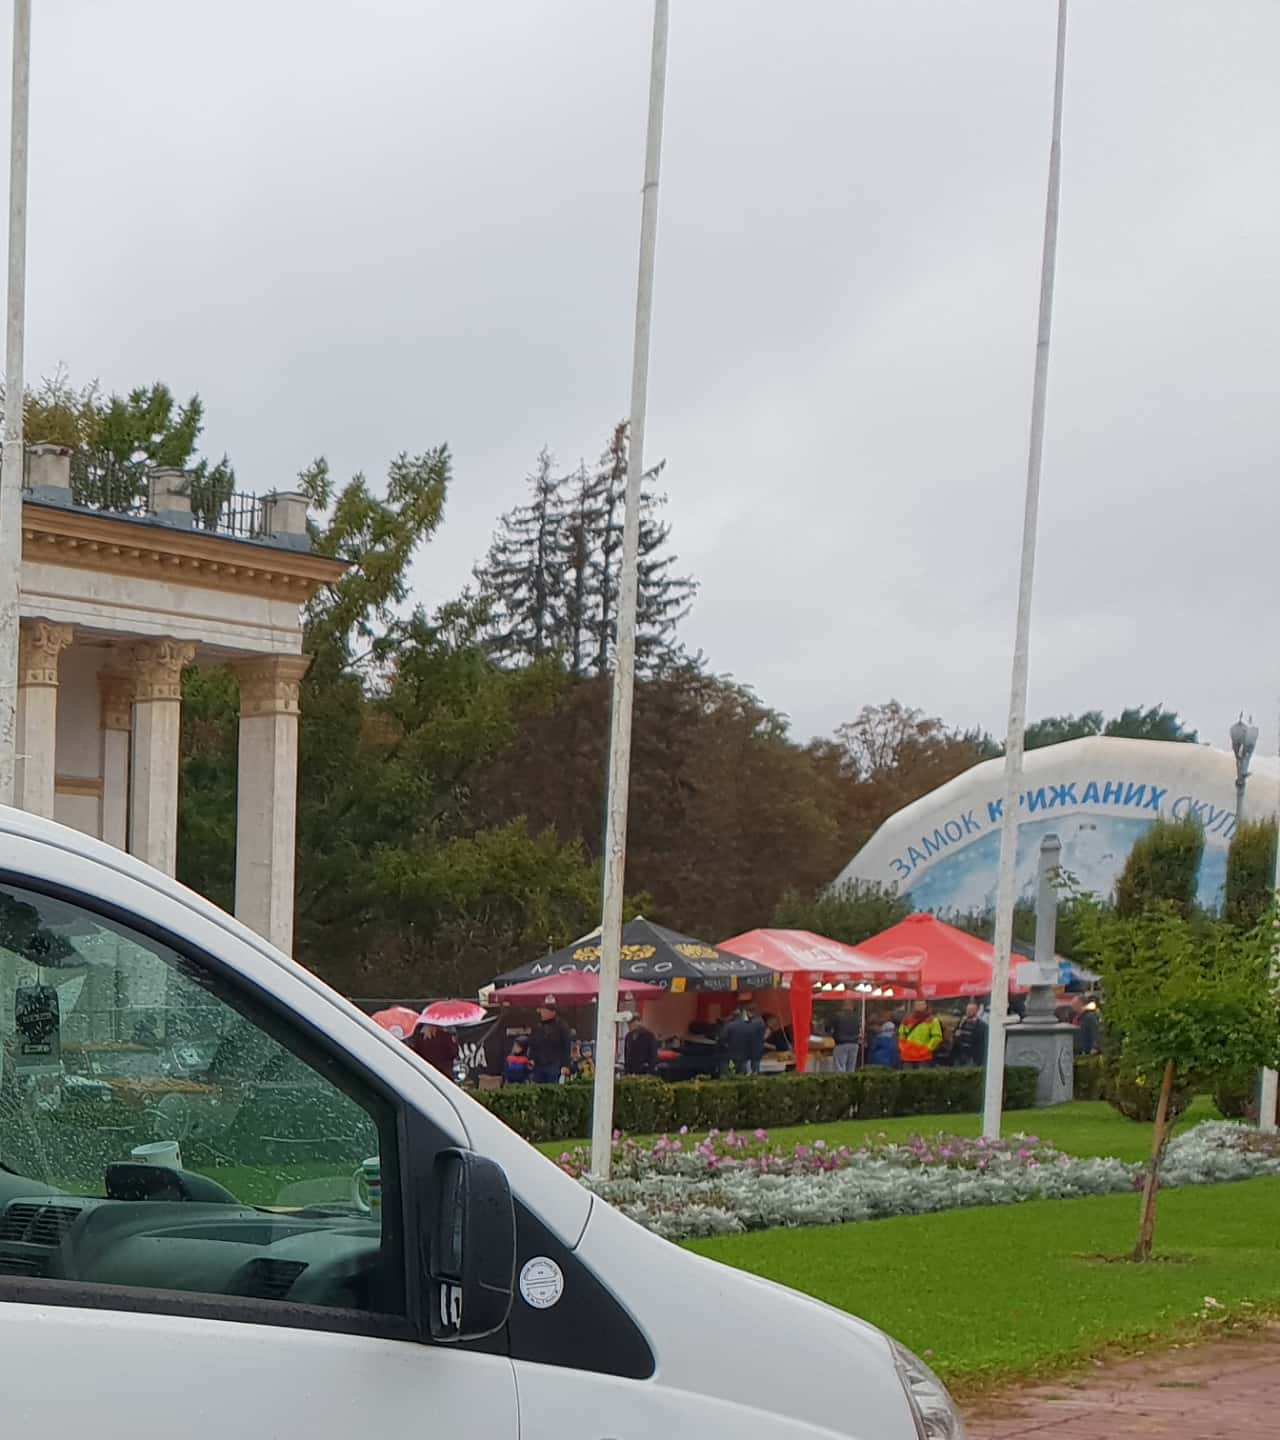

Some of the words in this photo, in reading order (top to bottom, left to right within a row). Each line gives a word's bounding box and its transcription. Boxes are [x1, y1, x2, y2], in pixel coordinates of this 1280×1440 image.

[889, 810, 981, 880] ЗАМОК
[987, 781, 1168, 822] КИЖАНИХ
[531, 961, 673, 976] MONCO
